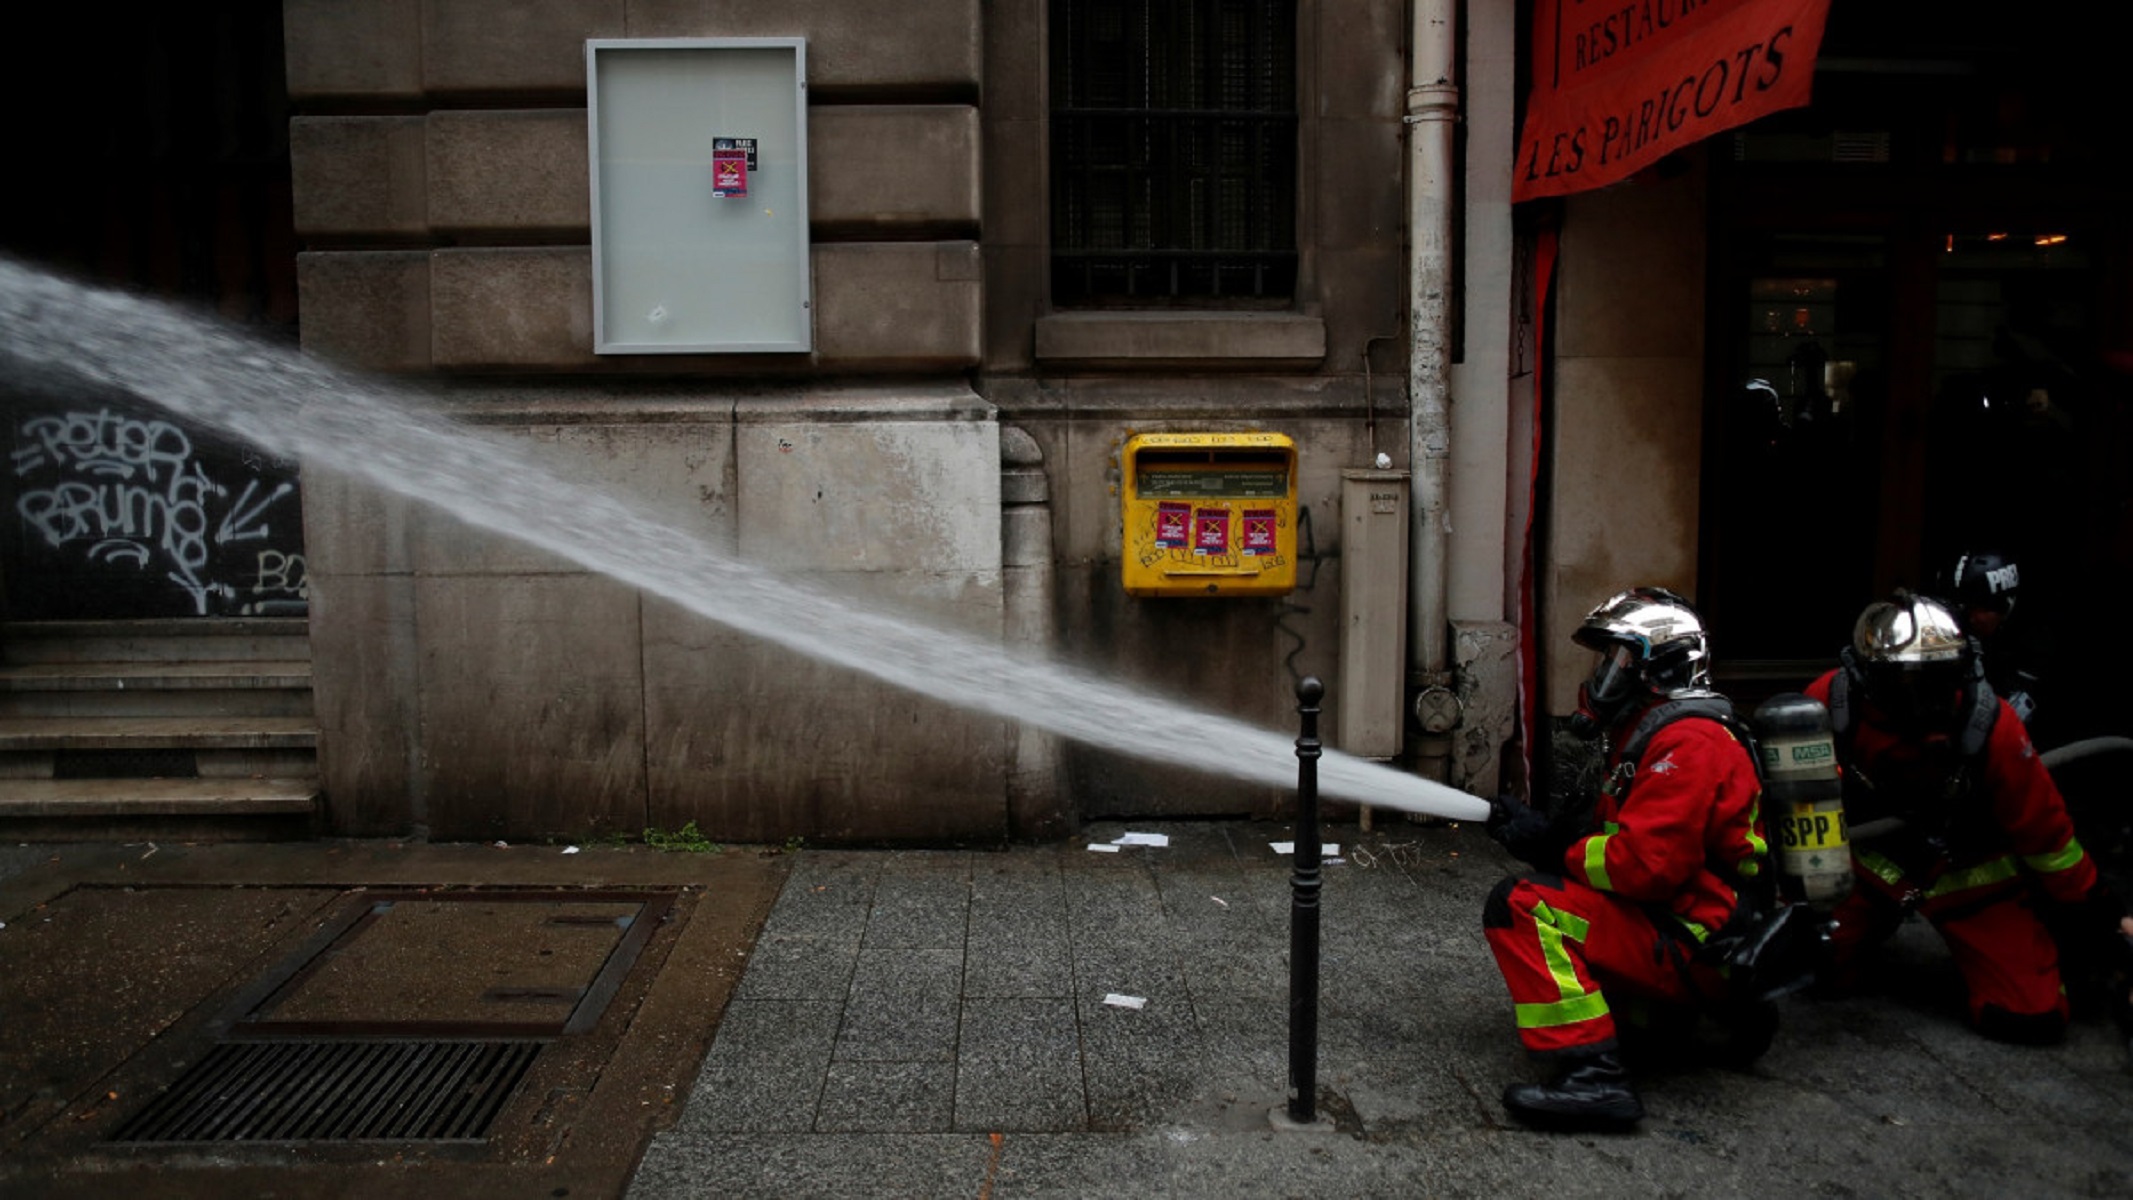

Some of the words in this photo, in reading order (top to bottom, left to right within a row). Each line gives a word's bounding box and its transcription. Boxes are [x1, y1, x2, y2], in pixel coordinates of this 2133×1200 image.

[1526, 128, 1584, 181] LES
[1599, 26, 1792, 166] PARIGOTS
[1793, 743, 1832, 761] MSA
